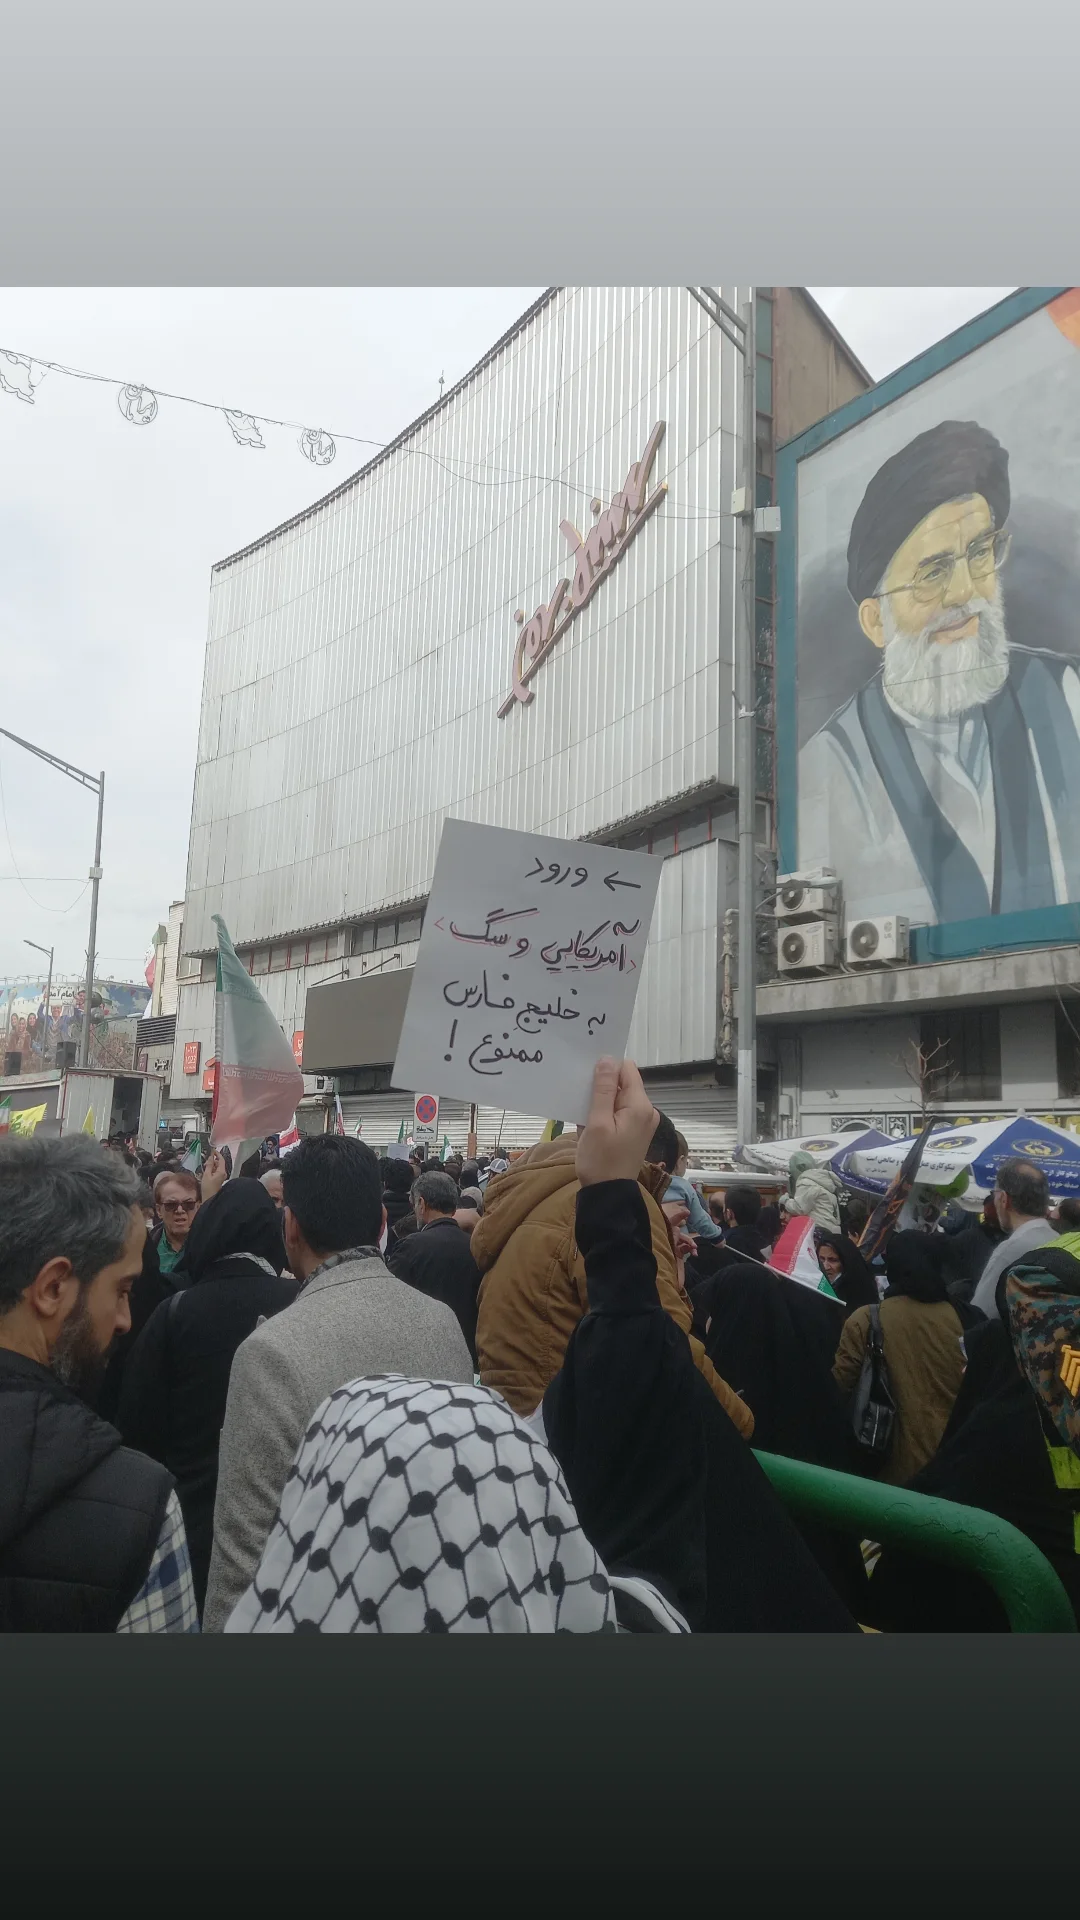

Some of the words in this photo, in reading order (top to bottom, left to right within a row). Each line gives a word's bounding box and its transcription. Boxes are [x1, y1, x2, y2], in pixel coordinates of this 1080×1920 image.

[524, 857, 589, 888] ورود
[508, 937, 531, 958] و
[442, 969, 516, 1010] فارس
[515, 988, 581, 1034] خلیج
[587, 1012, 607, 1036] به
[468, 1032, 544, 1076] ممنوع
